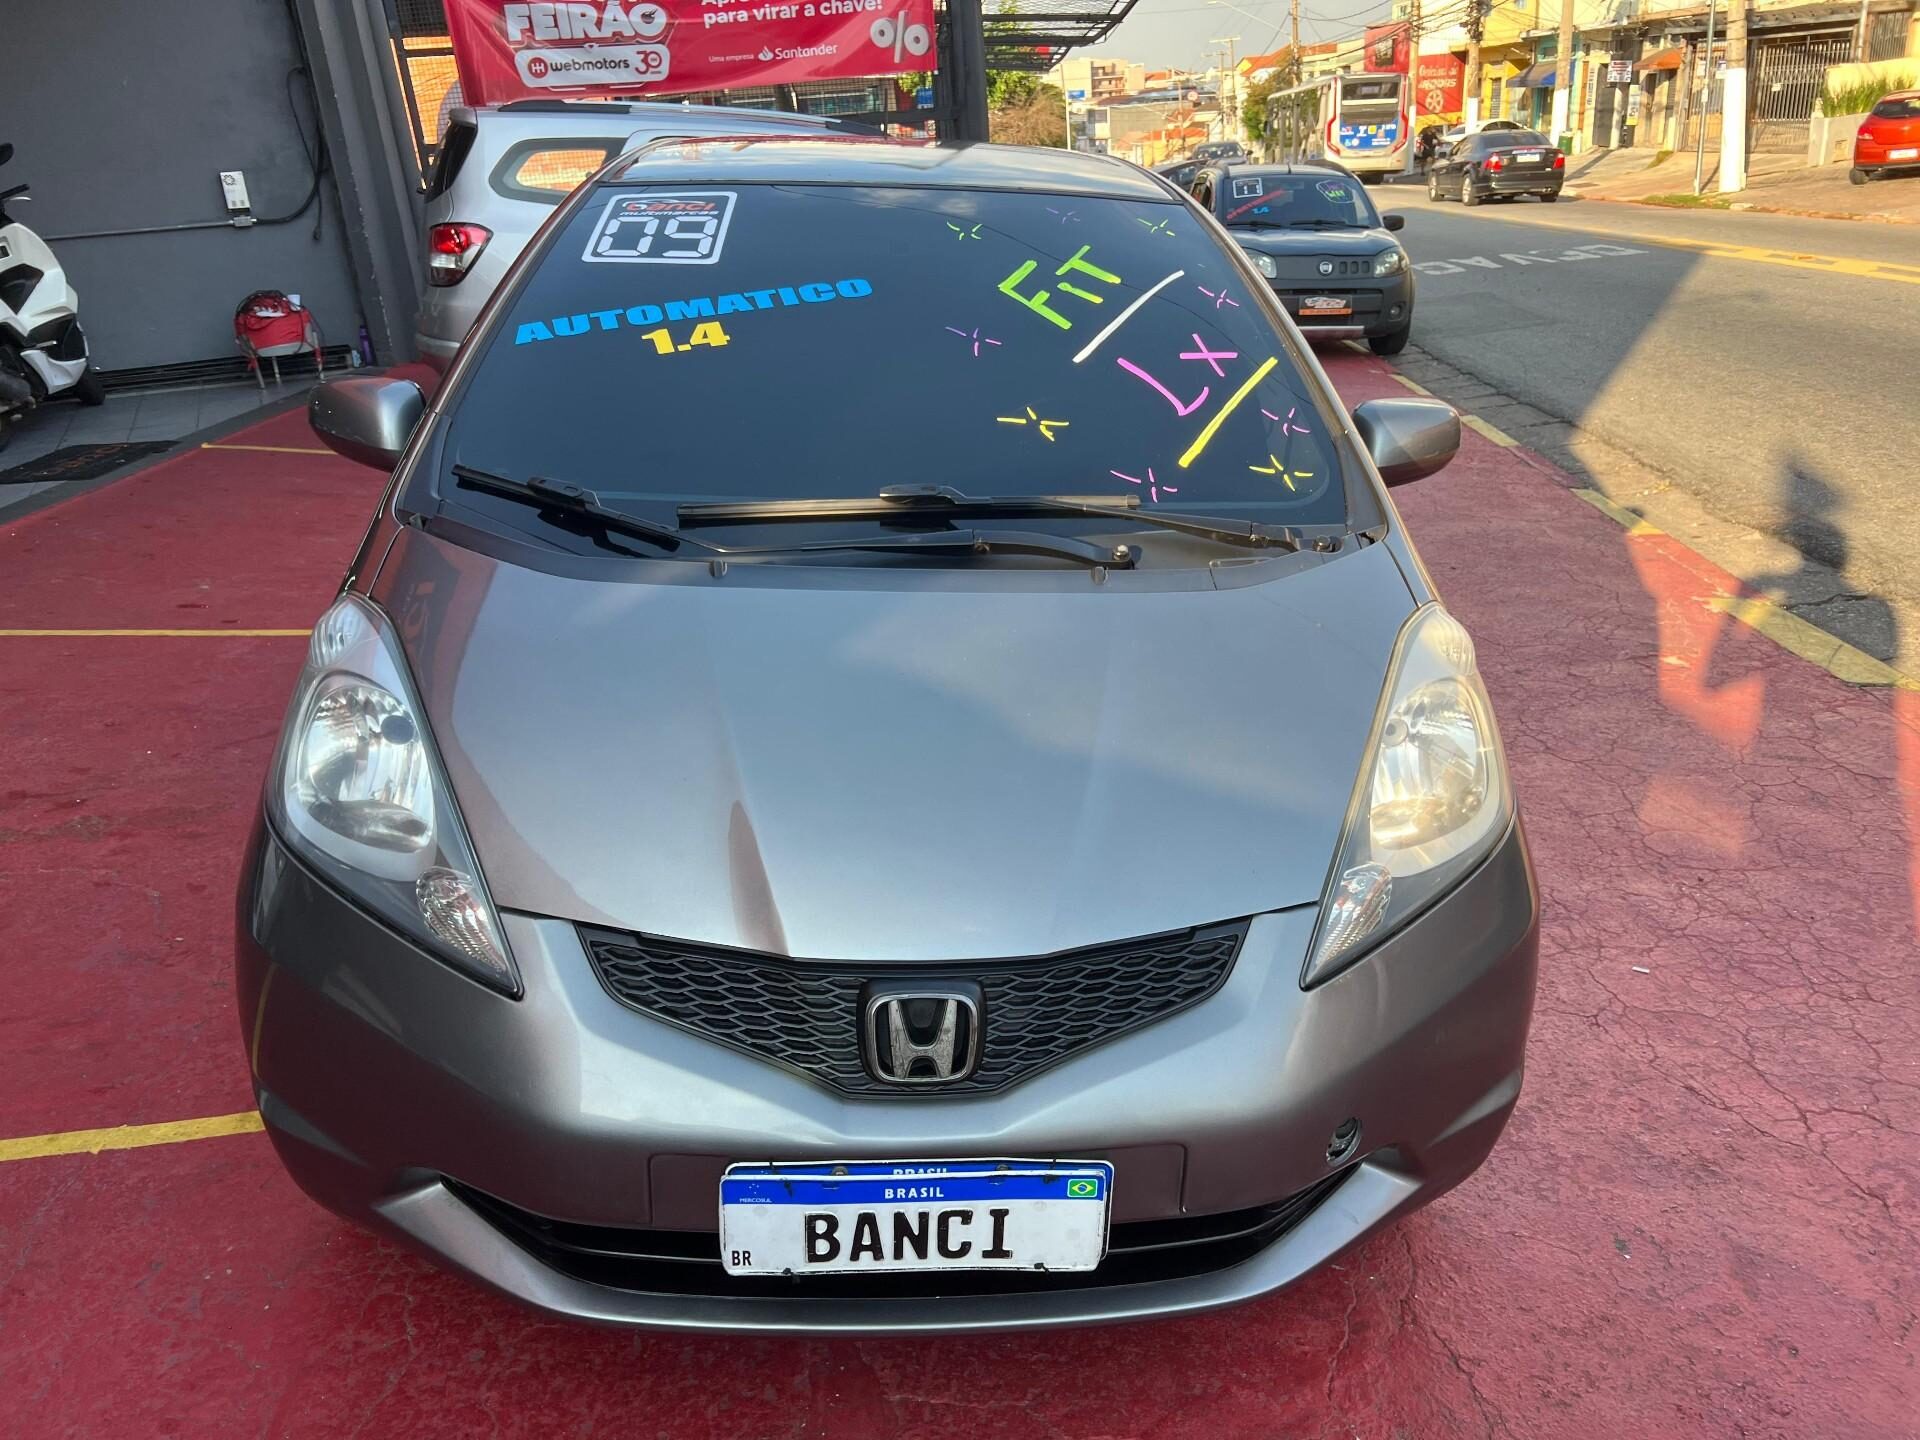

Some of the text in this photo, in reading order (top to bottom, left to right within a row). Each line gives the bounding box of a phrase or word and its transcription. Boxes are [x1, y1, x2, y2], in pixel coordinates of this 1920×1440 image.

[703, 0, 883, 28] para virar a chave!
[550, 58, 630, 72] webmotors
[708, 44, 837, 63] Uma empresa Santander
[597, 216, 719, 258] 09
[515, 278, 873, 345] AUTOMATICO
[641, 321, 731, 355] 1.4
[884, 1187, 945, 1199] BRASIL
[804, 1208, 1013, 1264] BANCI
[731, 1250, 752, 1266] BR
